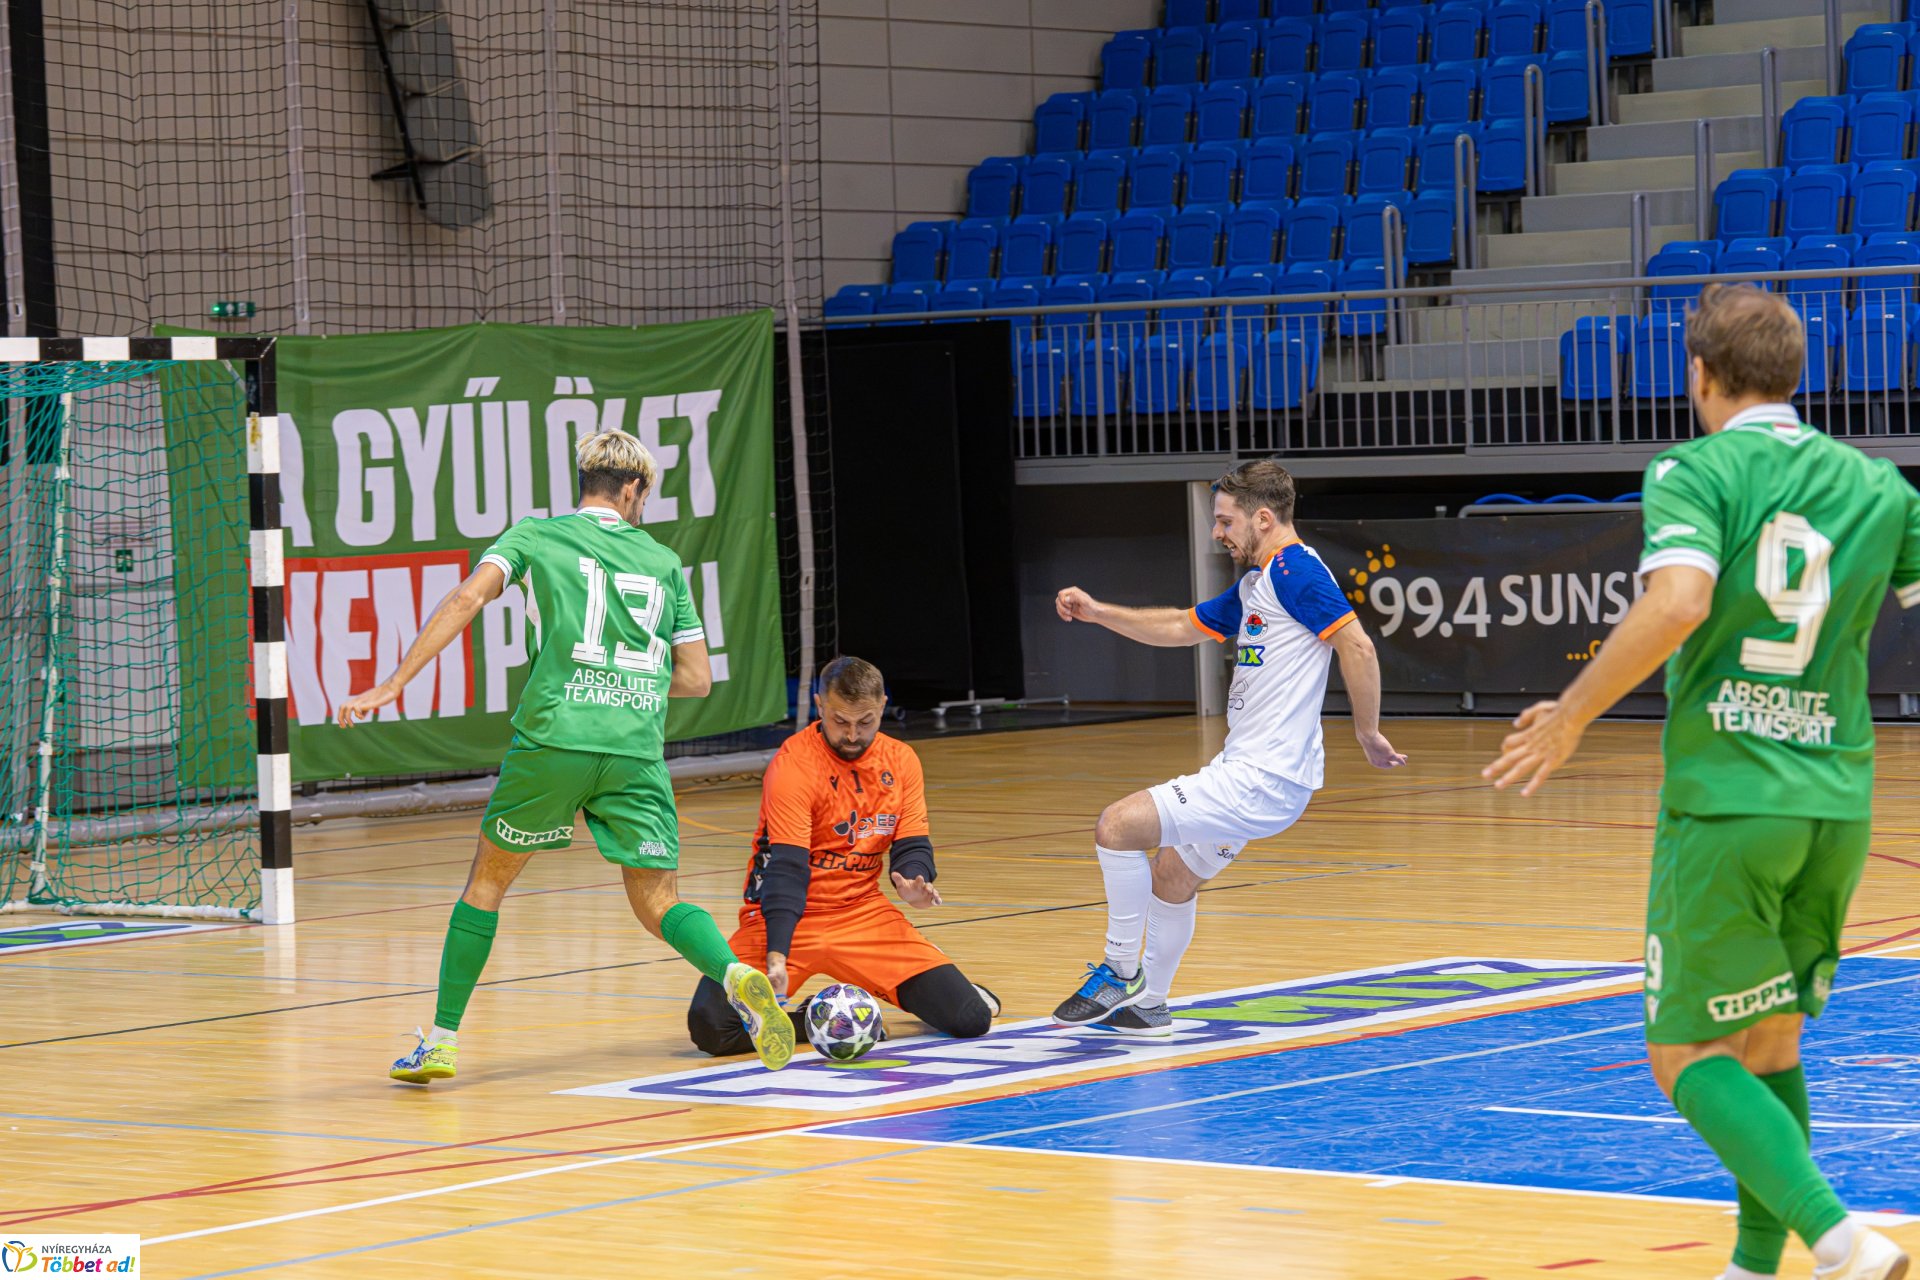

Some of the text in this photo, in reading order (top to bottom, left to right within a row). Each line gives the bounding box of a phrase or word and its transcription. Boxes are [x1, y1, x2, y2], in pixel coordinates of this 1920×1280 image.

[1369, 571, 1647, 638] 99.4 SUNS
[1740, 510, 1834, 676] 9
[571, 557, 667, 674] 13
[564, 684, 662, 713] TEAMSPORT
[572, 667, 658, 695] ABSOLUTE
[1716, 679, 1830, 717] ABSOLUTE
[850, 769, 864, 793] 1
[1172, 784, 1187, 804] JAKO
[1647, 934, 1662, 991] 9
